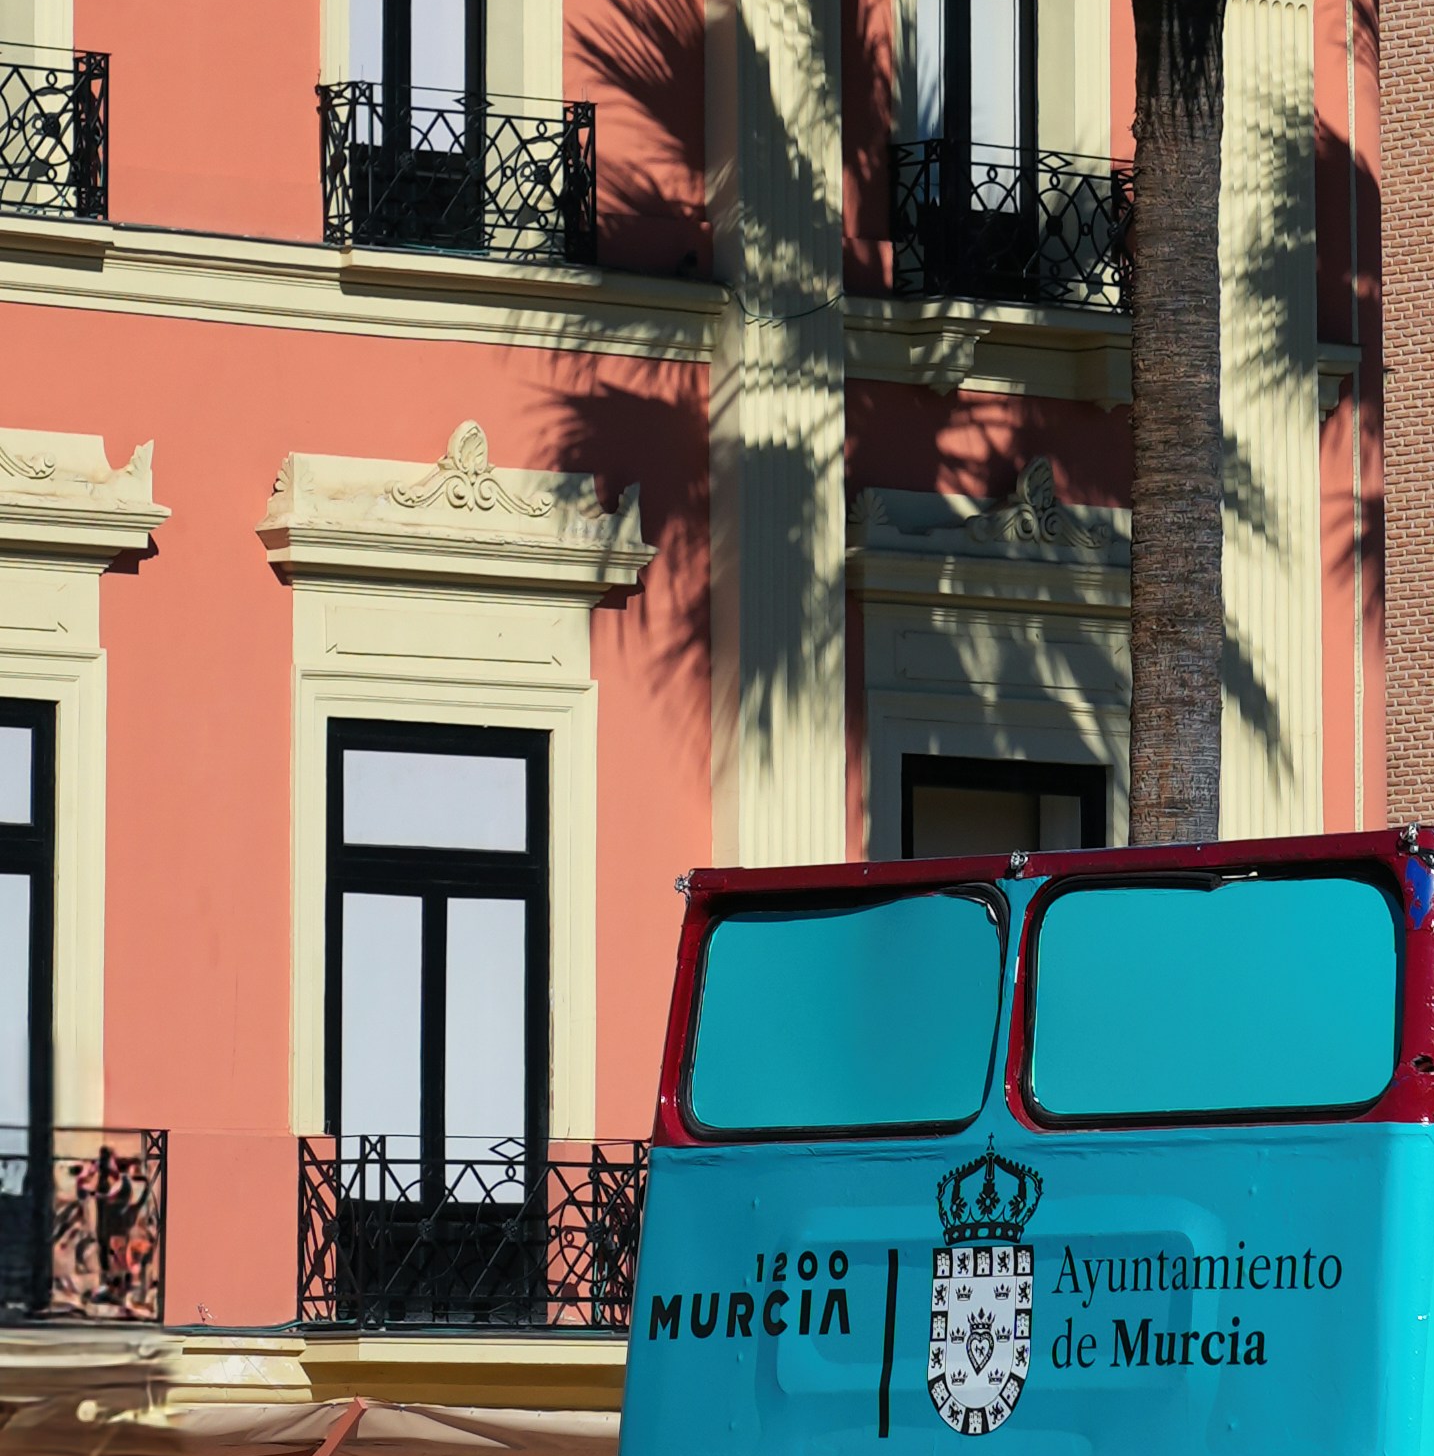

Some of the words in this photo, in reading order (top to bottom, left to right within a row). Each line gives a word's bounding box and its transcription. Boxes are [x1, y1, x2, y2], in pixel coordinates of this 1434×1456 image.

[755, 1249, 849, 1283] 1200
[1051, 1240, 1343, 1309] Ayuntamiento
[647, 1288, 851, 1341] MURCIA
[1051, 1316, 1097, 1369] de
[1109, 1316, 1268, 1368] Murcia
